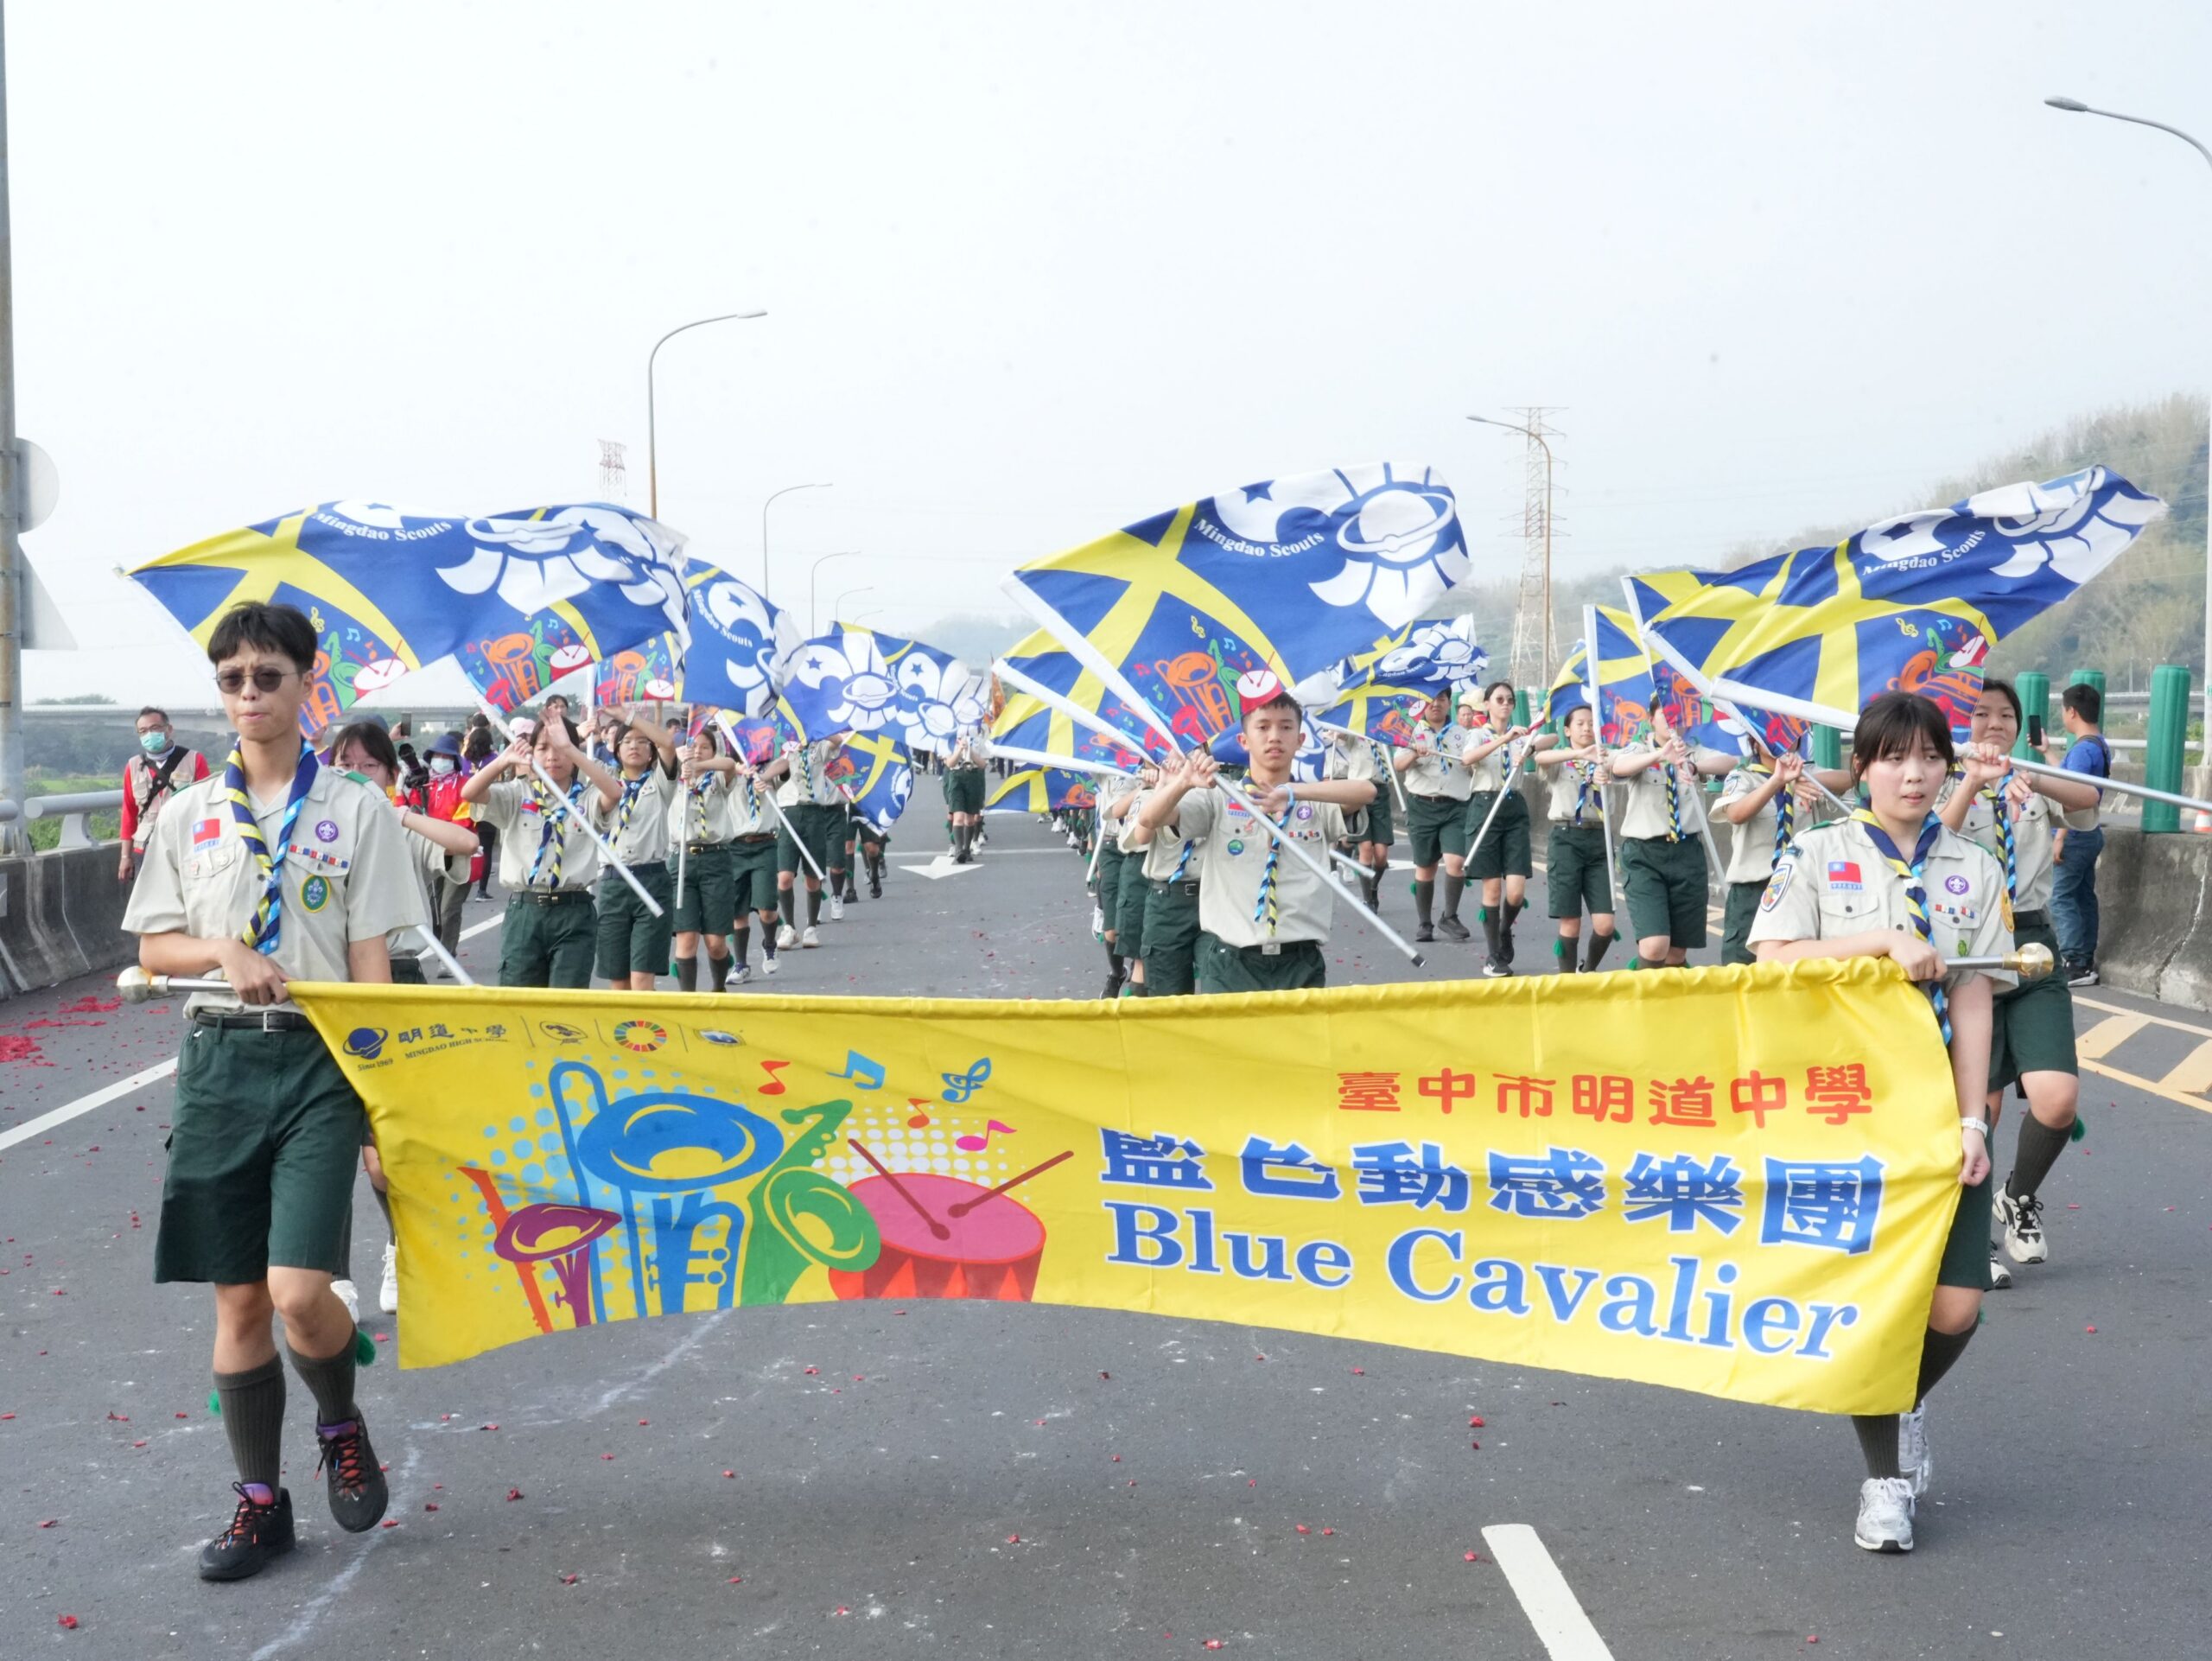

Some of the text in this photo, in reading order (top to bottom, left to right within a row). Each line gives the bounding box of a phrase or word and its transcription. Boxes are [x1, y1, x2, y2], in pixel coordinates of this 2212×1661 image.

[311, 512, 453, 542] Mingdao Scouts
[1193, 519, 1325, 557] Mingdao Scouts
[1942, 530, 1986, 563] Scouts
[721, 627, 753, 648] Scouts
[405, 1038, 473, 1059] MINGDAO HIGH
[358, 1058, 394, 1072] Since 1969
[1337, 1063, 1873, 1129] 臺中市明道中學
[1103, 1201, 1859, 1358] Blue Cavalier
